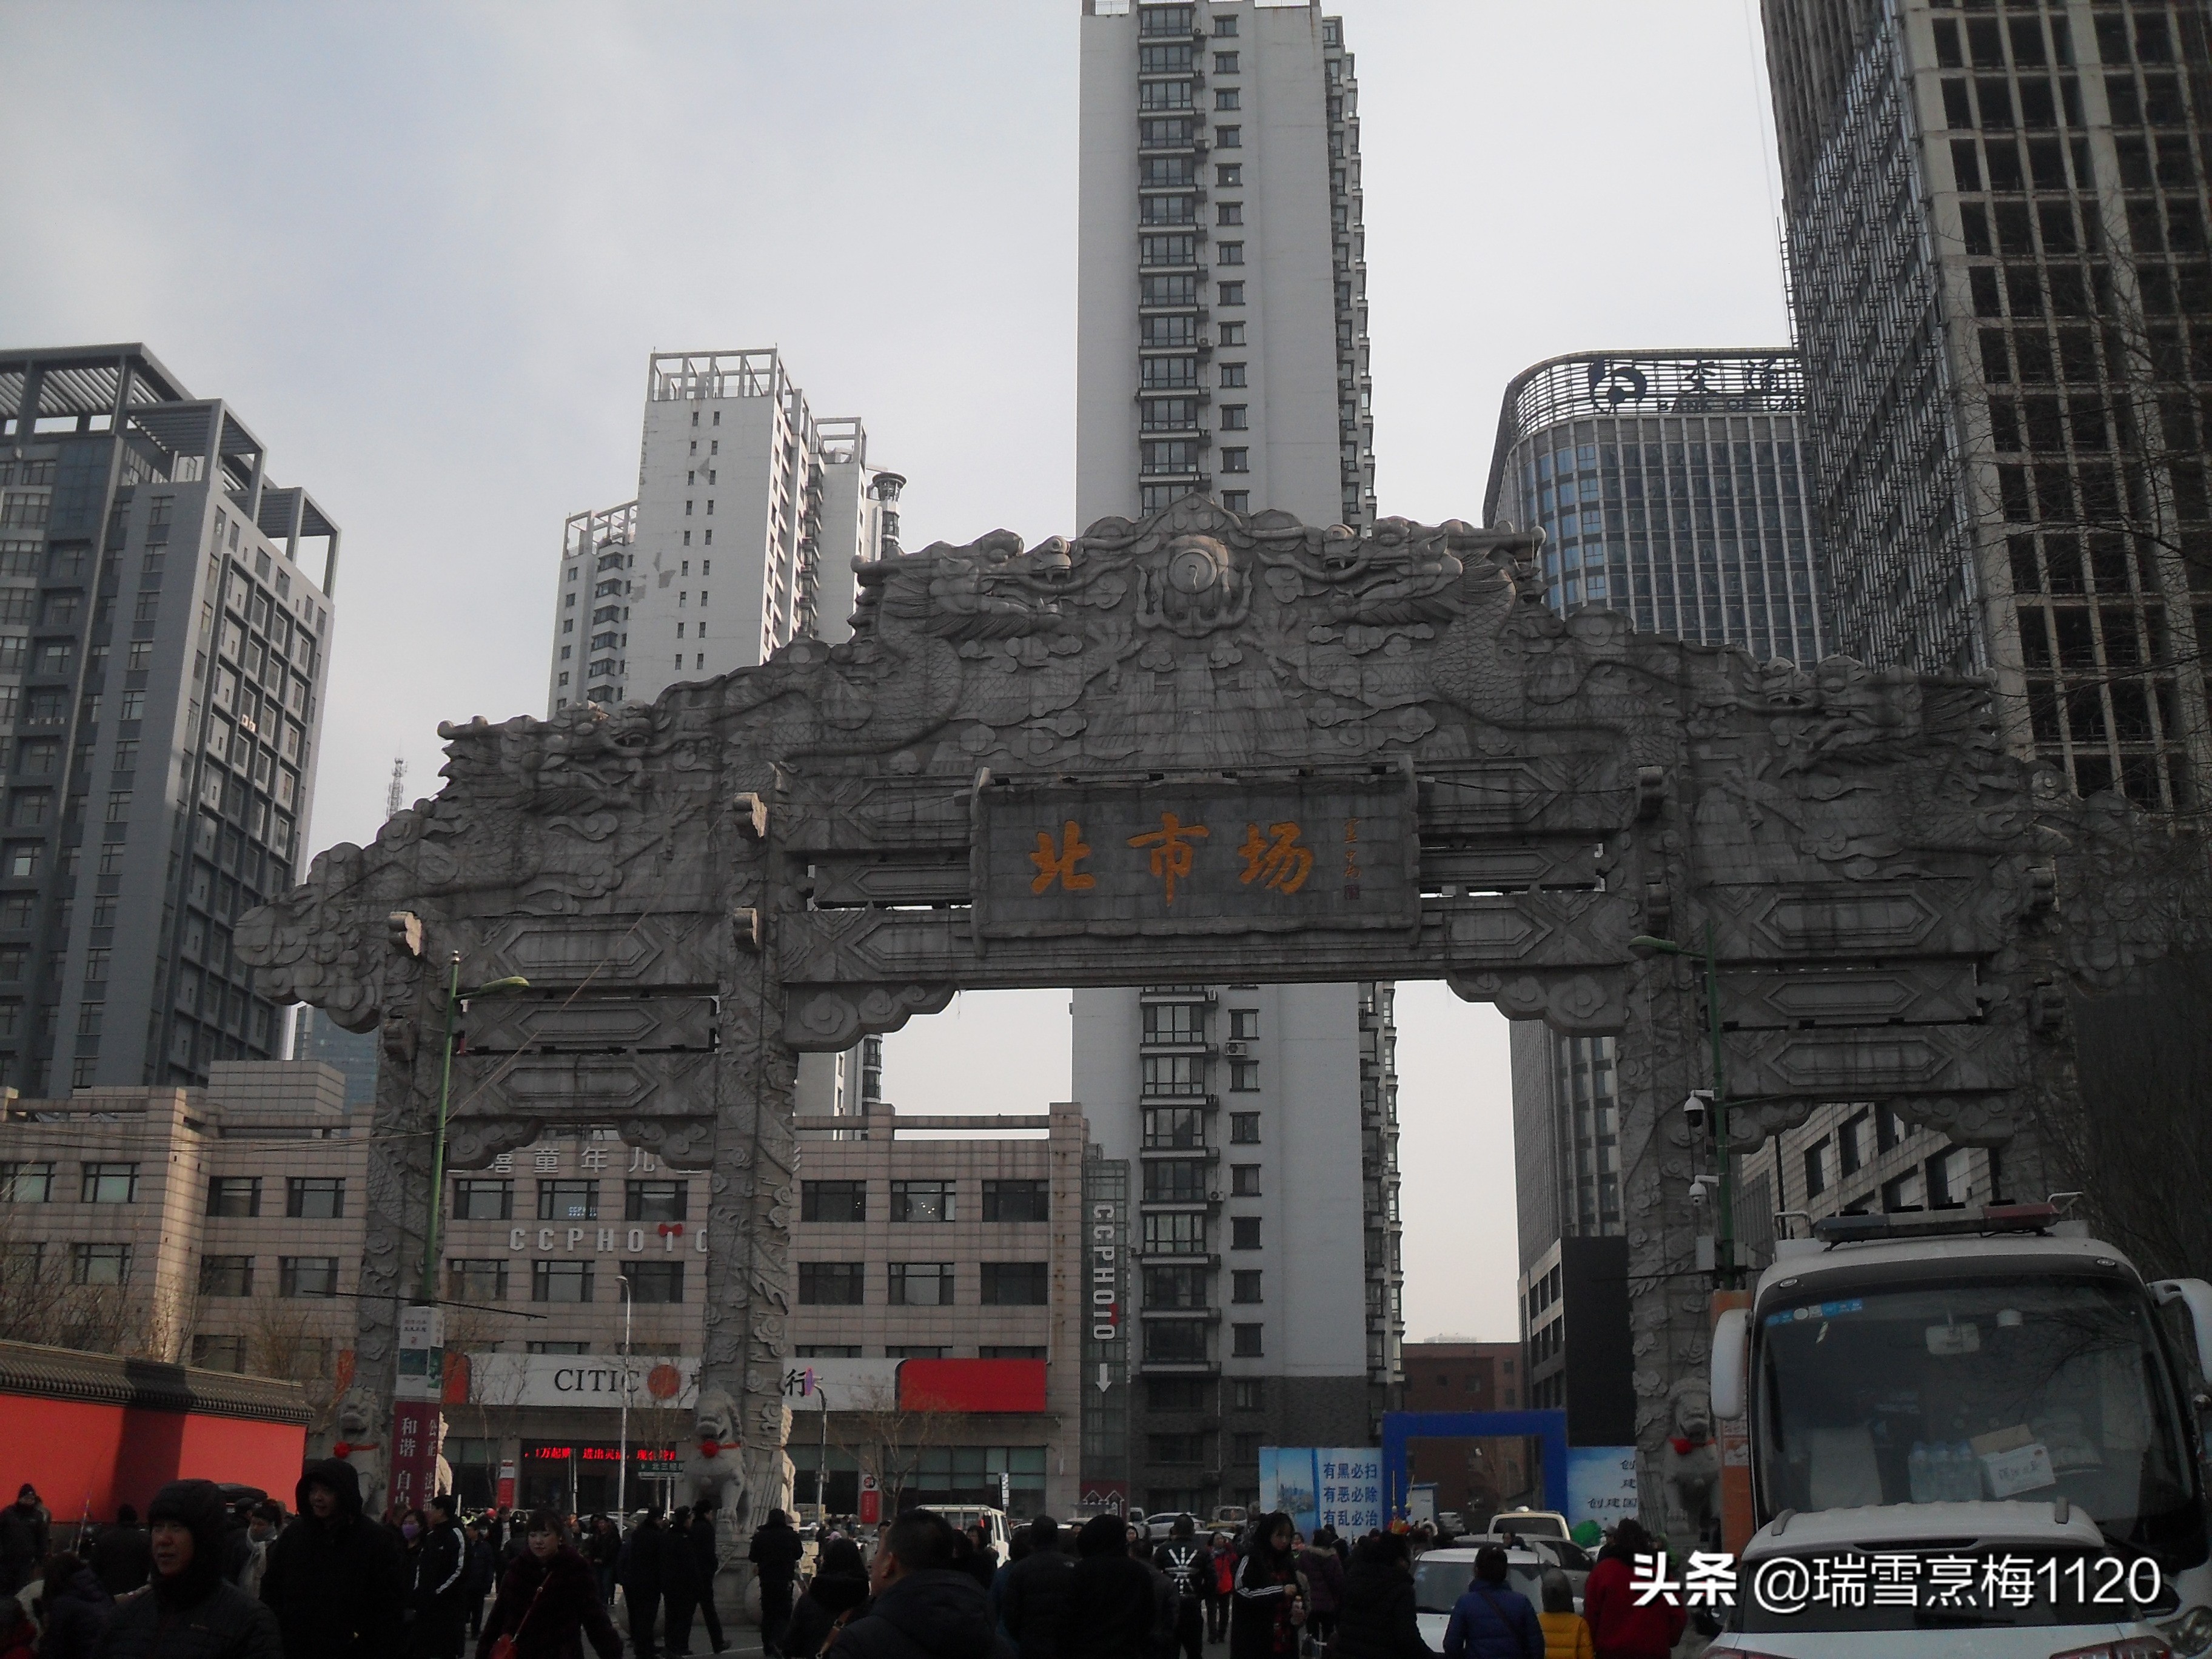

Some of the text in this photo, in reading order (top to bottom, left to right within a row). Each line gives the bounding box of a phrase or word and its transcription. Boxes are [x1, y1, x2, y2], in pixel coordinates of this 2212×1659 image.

[1028, 812, 1315, 907] 北市场
[554, 1369, 640, 1393] CITIC
[400, 1417, 417, 1457] 和谐
[427, 1419, 438, 1456] 公正
[1324, 1463, 1377, 1479] 有黑必扫
[1324, 1487, 1377, 1503] 有恶必除
[1587, 1498, 1637, 1509] 创建国
[1324, 1510, 1377, 1526] 有乱必治
